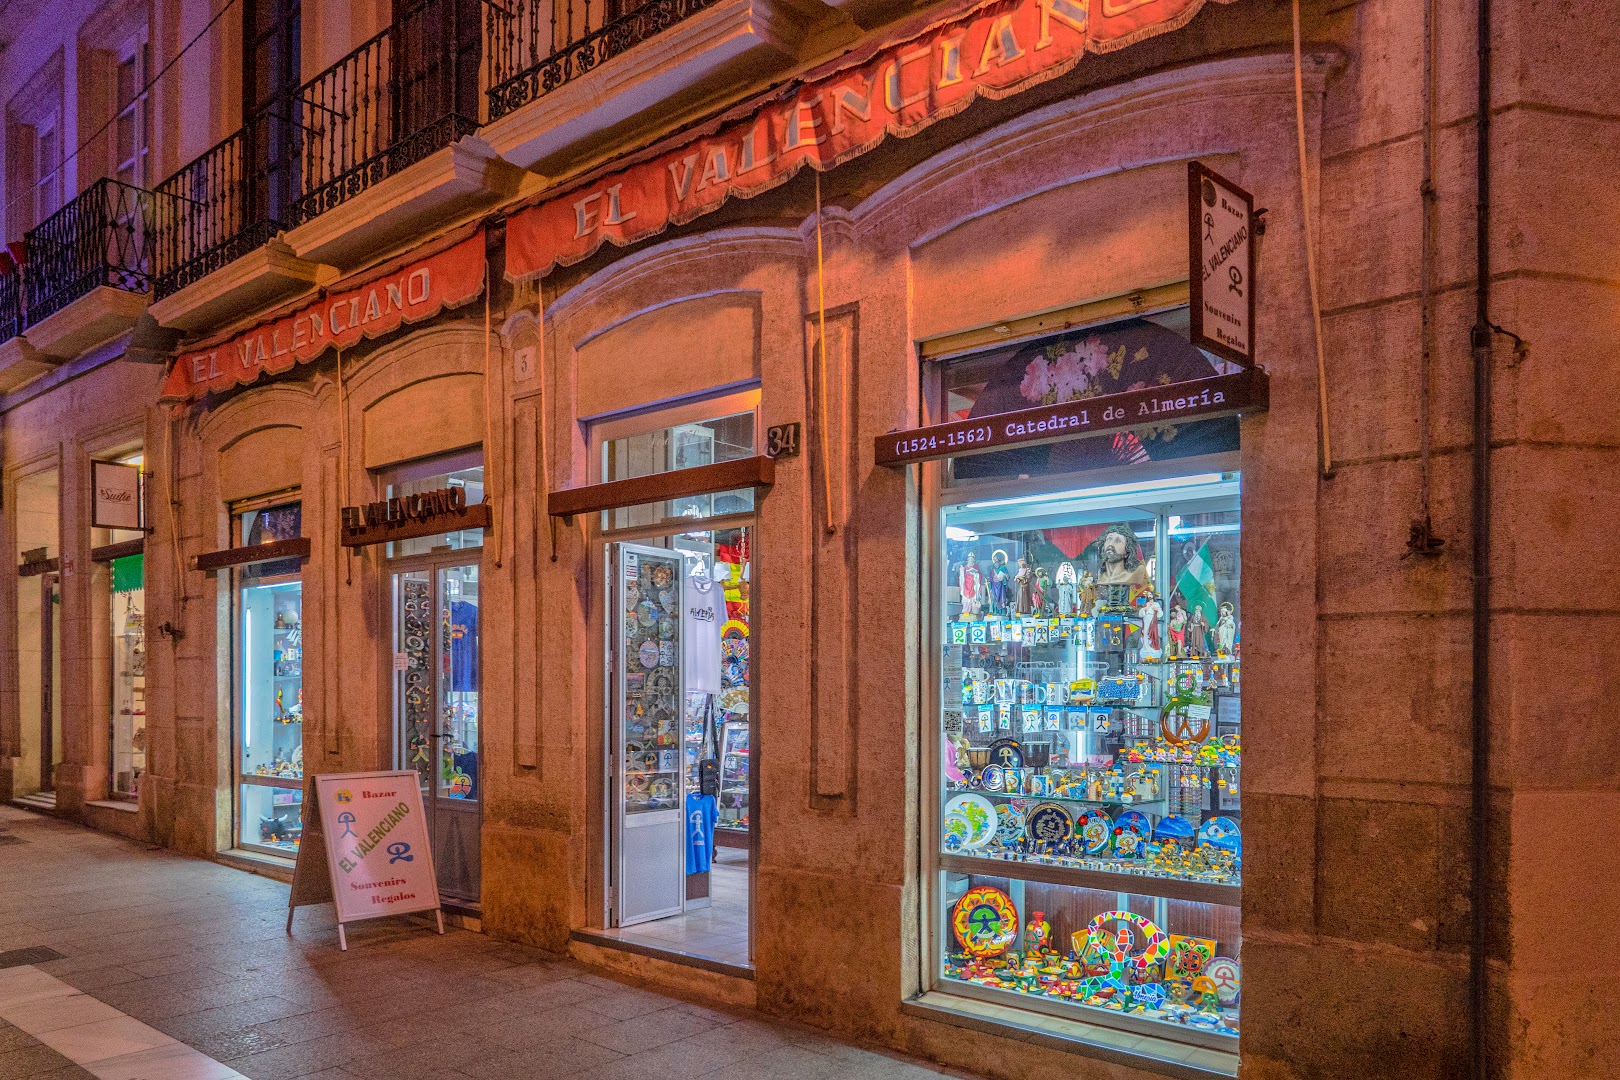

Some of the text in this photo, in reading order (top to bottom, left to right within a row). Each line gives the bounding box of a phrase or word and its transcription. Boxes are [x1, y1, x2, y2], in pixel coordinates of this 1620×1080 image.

[573, 183, 636, 241] EL
[1221, 198, 1243, 220] Bazar
[1208, 226, 1248, 271] VALENCIANO
[192, 267, 431, 384] EL VALENCIANO
[1204, 300, 1242, 327] Souvenirs
[1216, 327, 1246, 350] Regalos
[894, 389, 1226, 456] (1524-1562) Catedral de Almería
[768, 424, 796, 456] 34
[342, 506, 360, 529] EL
[361, 789, 398, 799] Bazar
[338, 801, 411, 874] EL VALENCIANO
[350, 877, 407, 891] Souvenirs
[371, 891, 416, 905] Regalos
